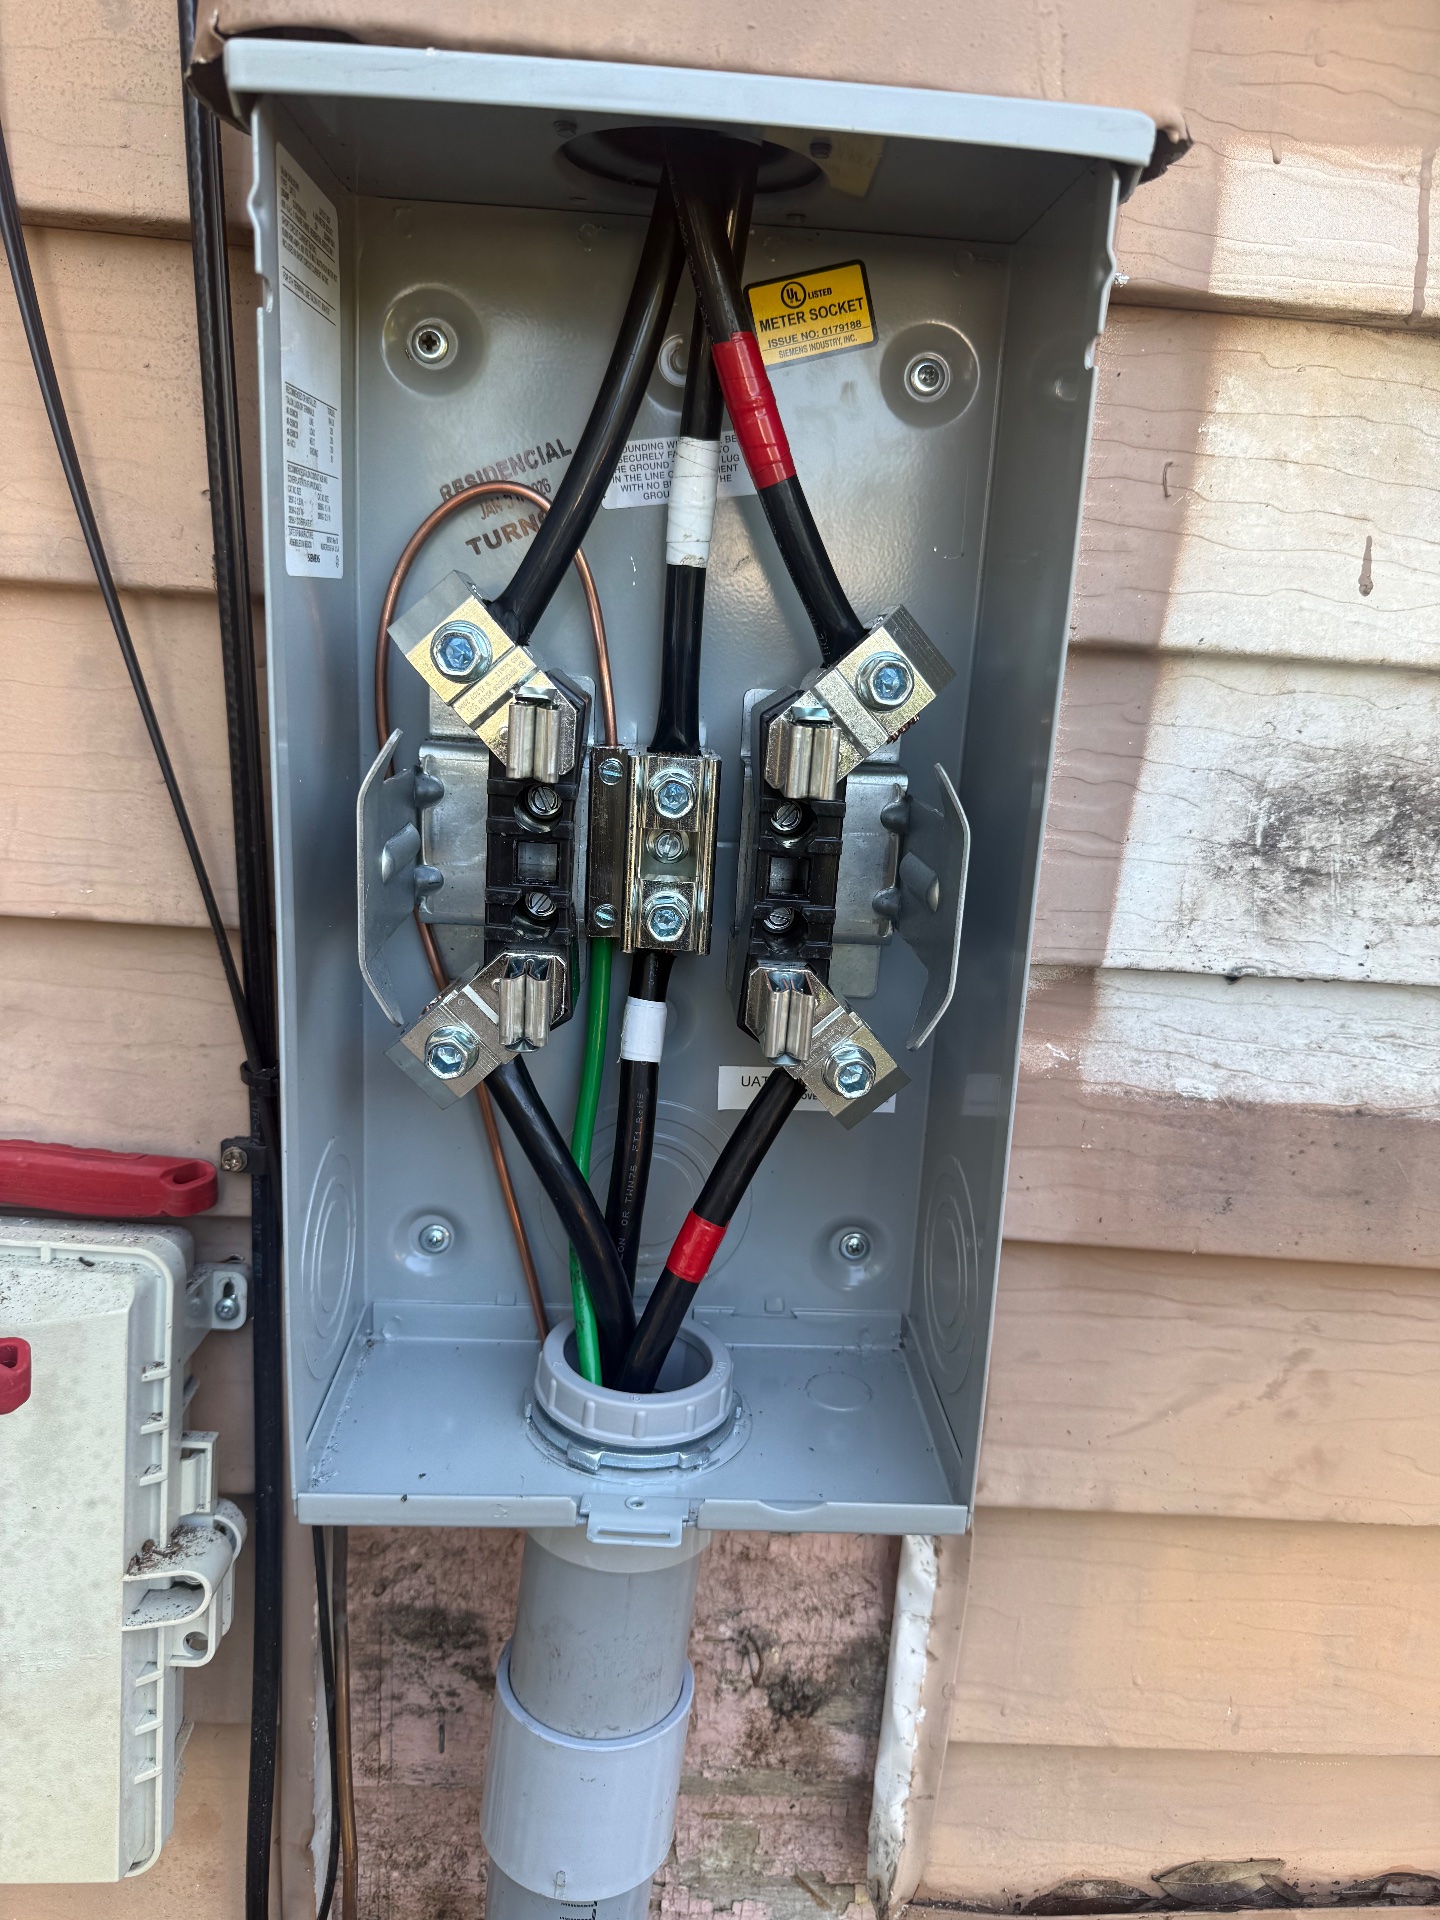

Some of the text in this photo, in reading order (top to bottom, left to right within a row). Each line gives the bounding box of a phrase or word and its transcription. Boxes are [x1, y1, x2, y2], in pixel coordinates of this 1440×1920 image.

[807, 287, 833, 300] LISTED
[759, 297, 864, 333] METER SOCKET
[767, 334, 799, 349] ISSUE
[801, 329, 820, 340] NO:
[778, 334, 858, 359] SIEMENS INDUSTRY, INC.
[721, 454, 740, 463] LUG
[439, 439, 573, 503] RESIDENCIAL
[629, 461, 670, 472] GROUND
[719, 464, 738, 473] ENT
[612, 475, 622, 484] IN
[624, 473, 643, 482] THE
[644, 471, 665, 481] LINE
[620, 483, 644, 492] WITH
[646, 482, 660, 490] NO
